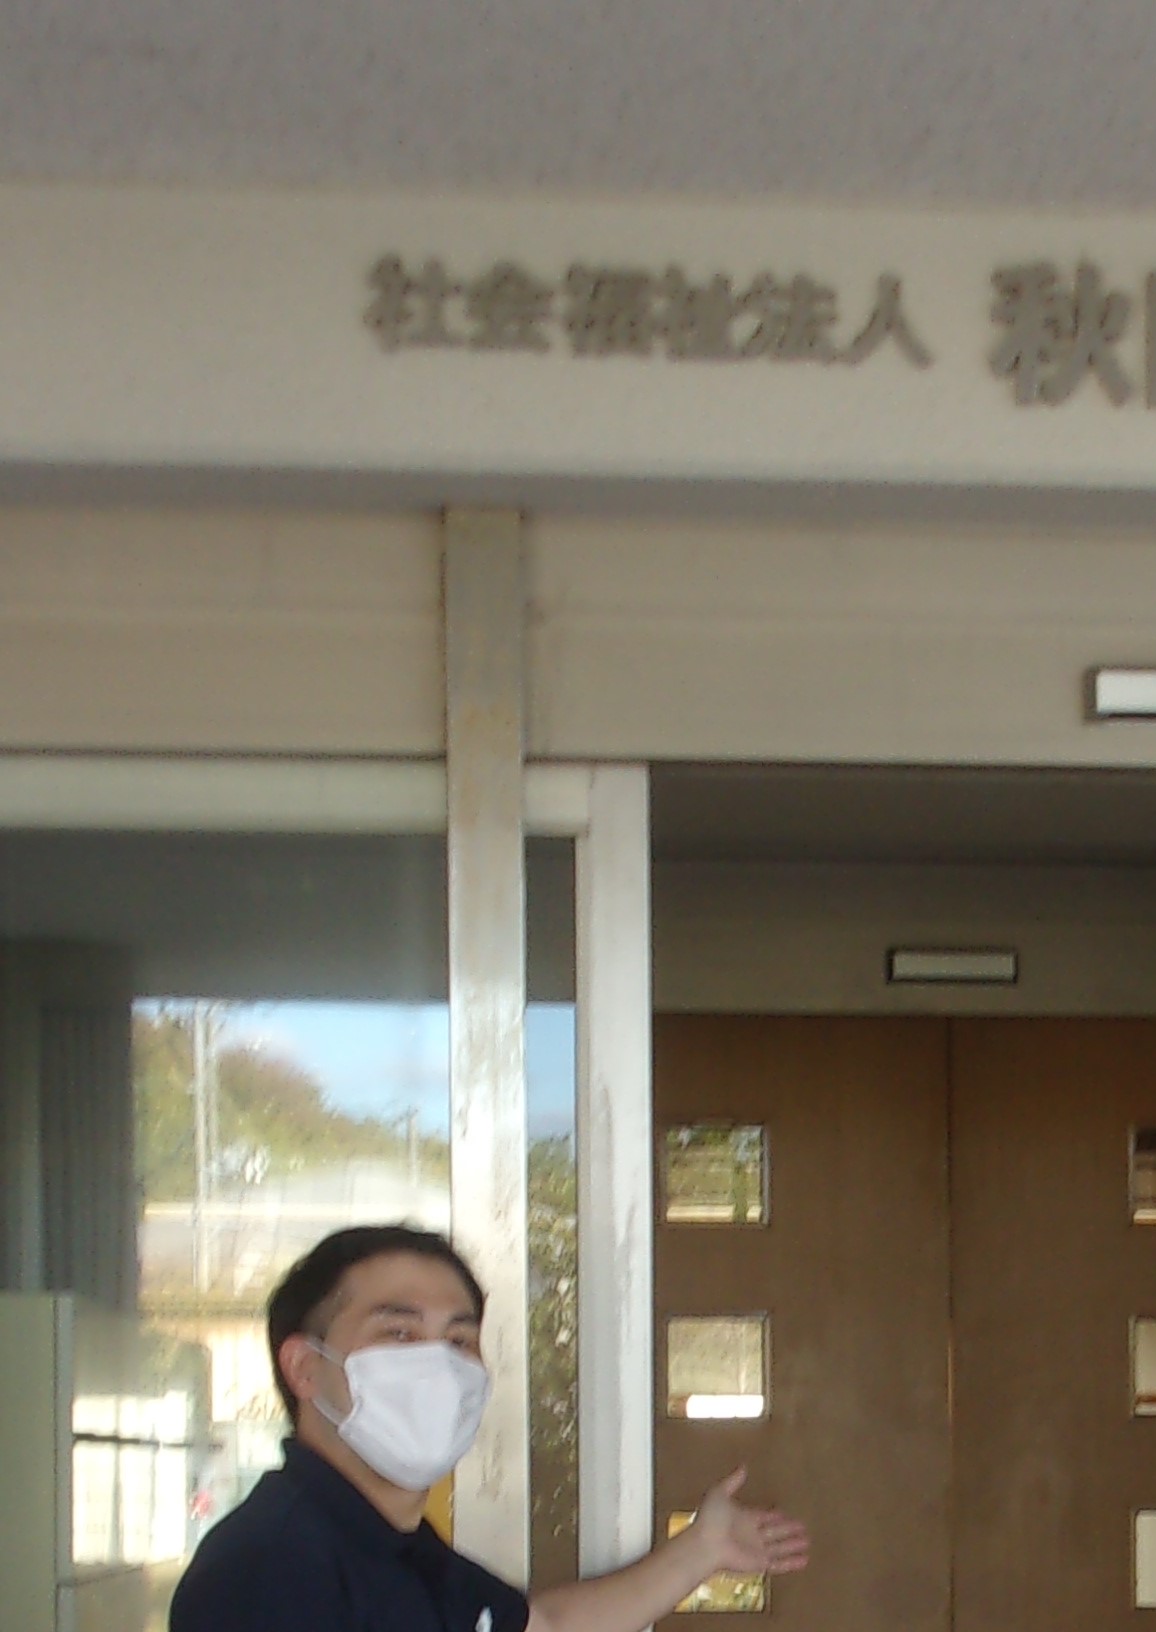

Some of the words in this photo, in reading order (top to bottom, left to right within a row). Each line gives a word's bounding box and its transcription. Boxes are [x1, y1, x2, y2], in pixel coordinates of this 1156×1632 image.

[363, 252, 934, 371] 社会福祉法人
